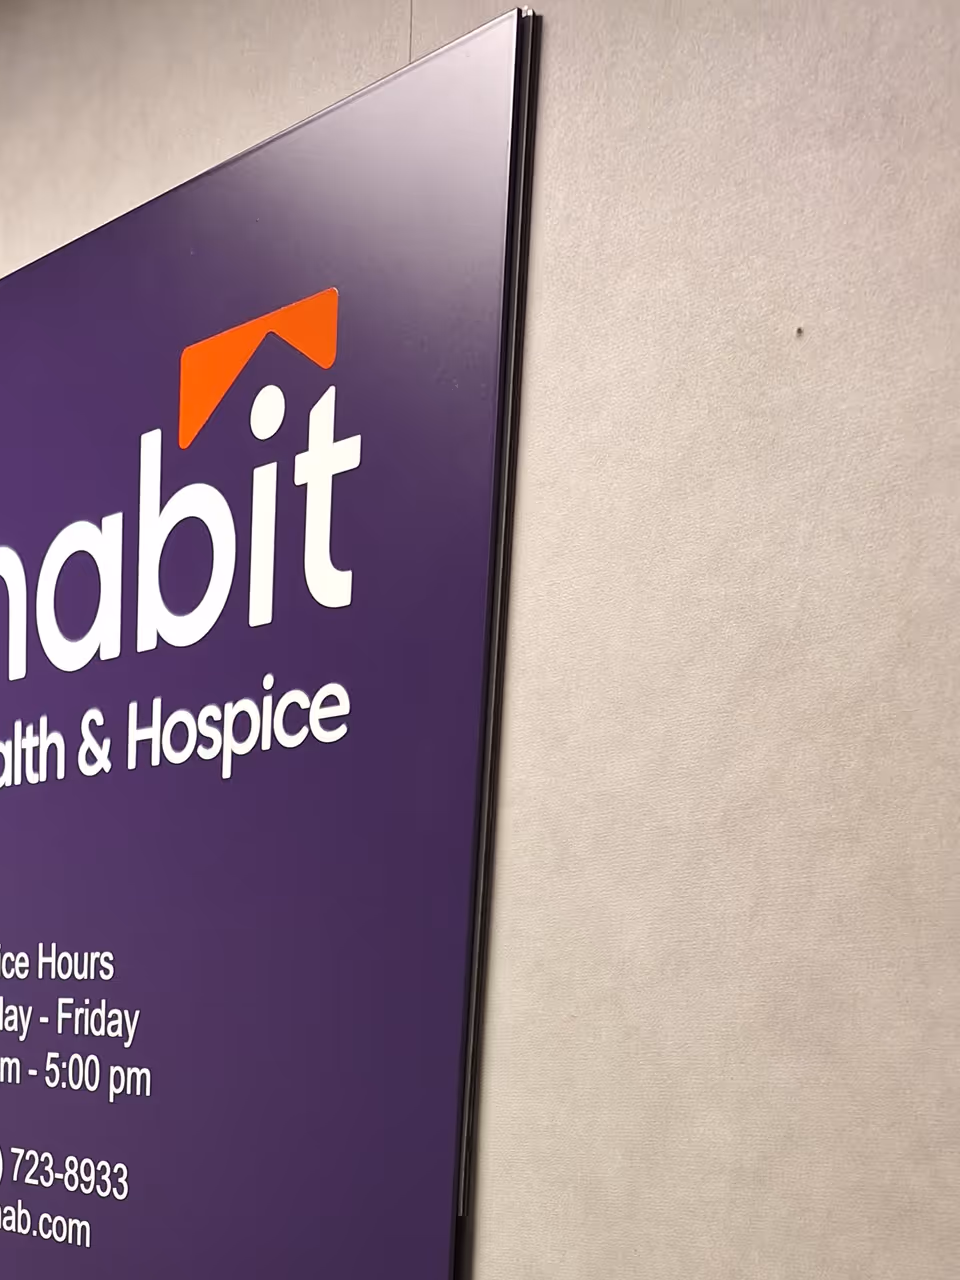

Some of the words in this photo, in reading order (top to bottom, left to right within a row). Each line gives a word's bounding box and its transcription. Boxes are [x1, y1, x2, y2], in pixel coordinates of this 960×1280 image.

[77, 707, 112, 777] &
[127, 672, 351, 779] Hospice
[37, 942, 115, 981] Hours
[57, 997, 141, 1048] Friday
[28, 1069, 38, 1077] -
[44, 1051, 100, 1092] 5:00
[109, 1065, 152, 1103] pm
[10, 1147, 129, 1200] 723-8933
